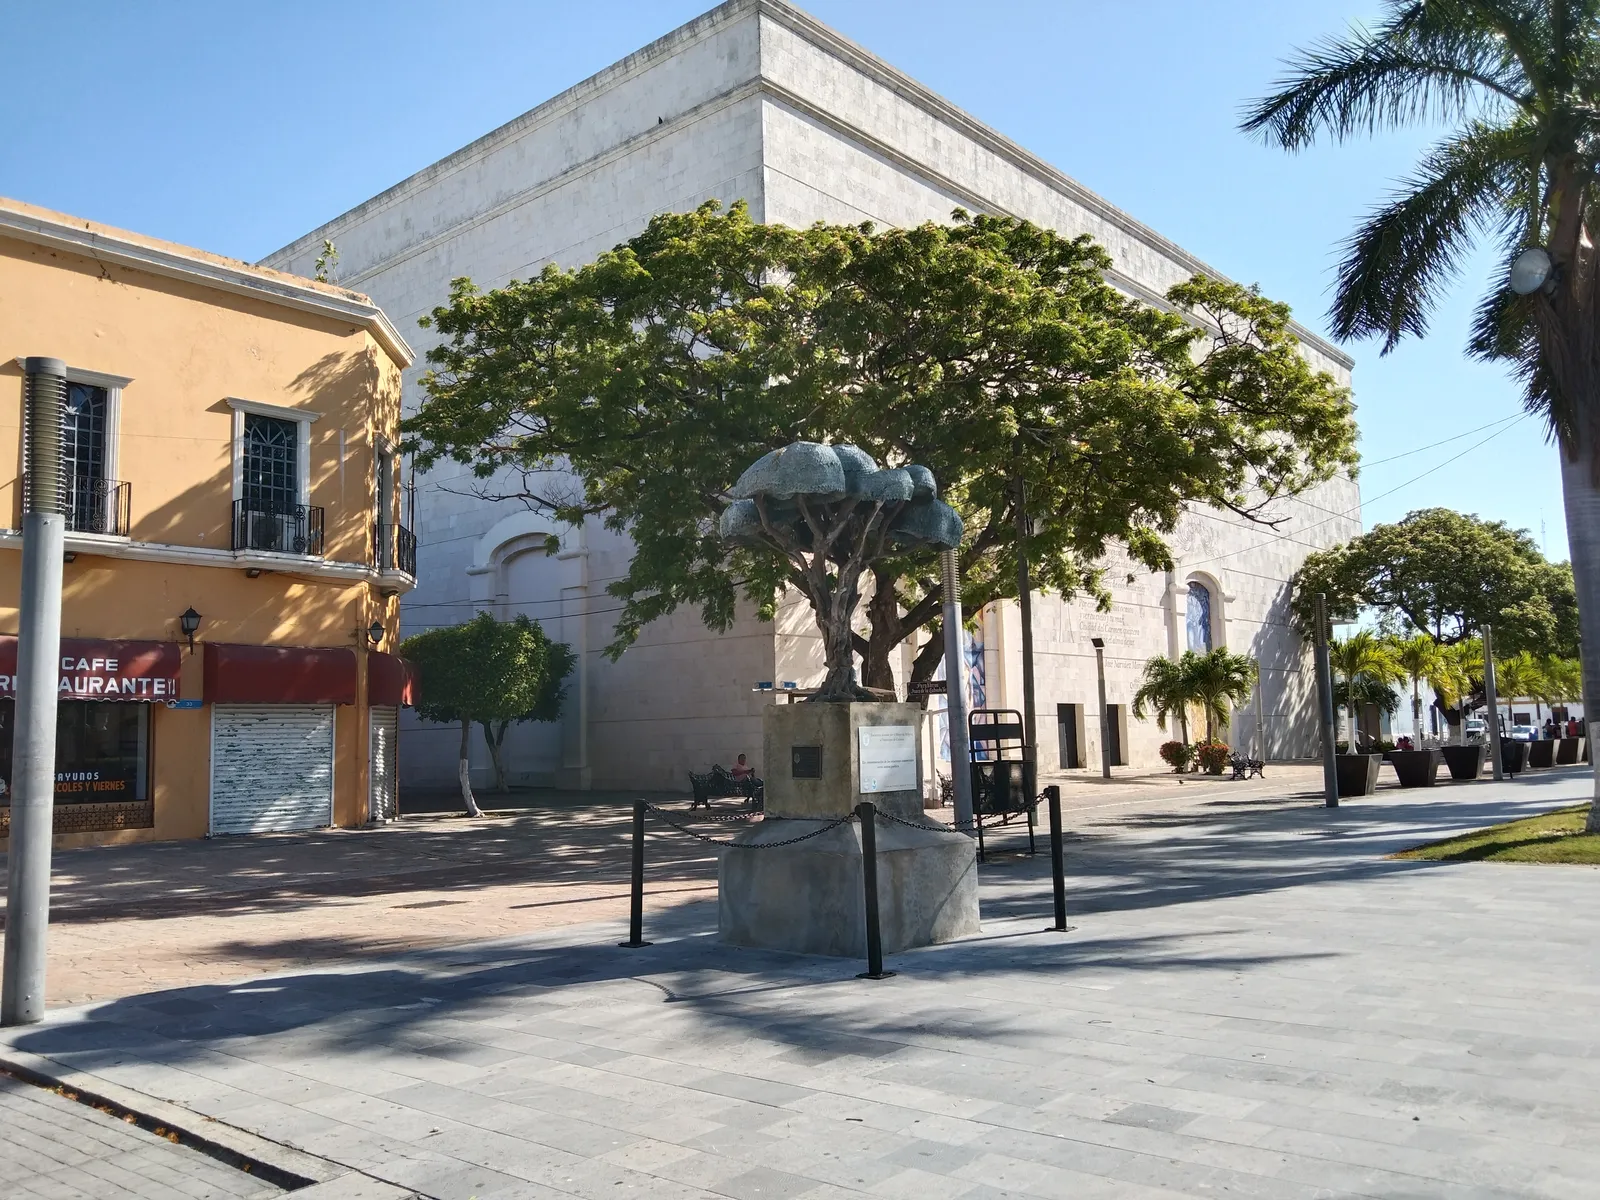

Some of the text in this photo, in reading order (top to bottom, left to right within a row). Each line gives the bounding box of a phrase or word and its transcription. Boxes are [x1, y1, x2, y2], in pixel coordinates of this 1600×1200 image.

[61, 656, 119, 672] CAFE
[0, 675, 166, 695] RAURANTE
[85, 781, 91, 791] Y
[93, 780, 125, 791] VIERNES
